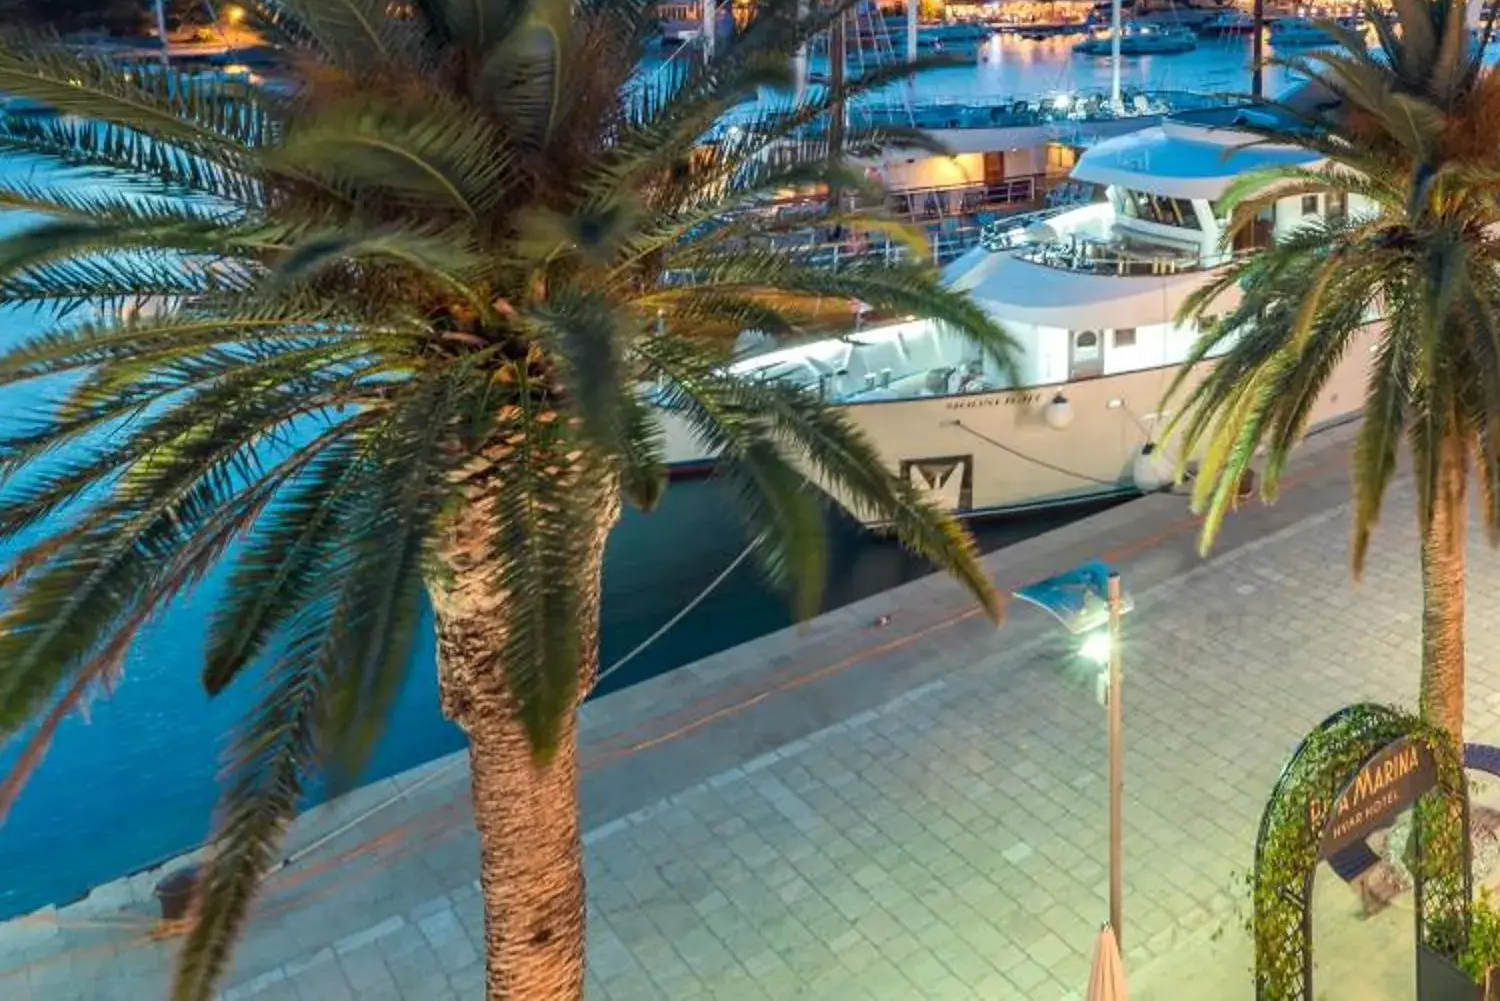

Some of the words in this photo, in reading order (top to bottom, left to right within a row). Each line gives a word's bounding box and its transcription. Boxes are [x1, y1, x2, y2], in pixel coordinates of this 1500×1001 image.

[1353, 745, 1419, 806] MARINA
[1333, 811, 1363, 839] HVAR
[1365, 790, 1398, 818] HOTEL
